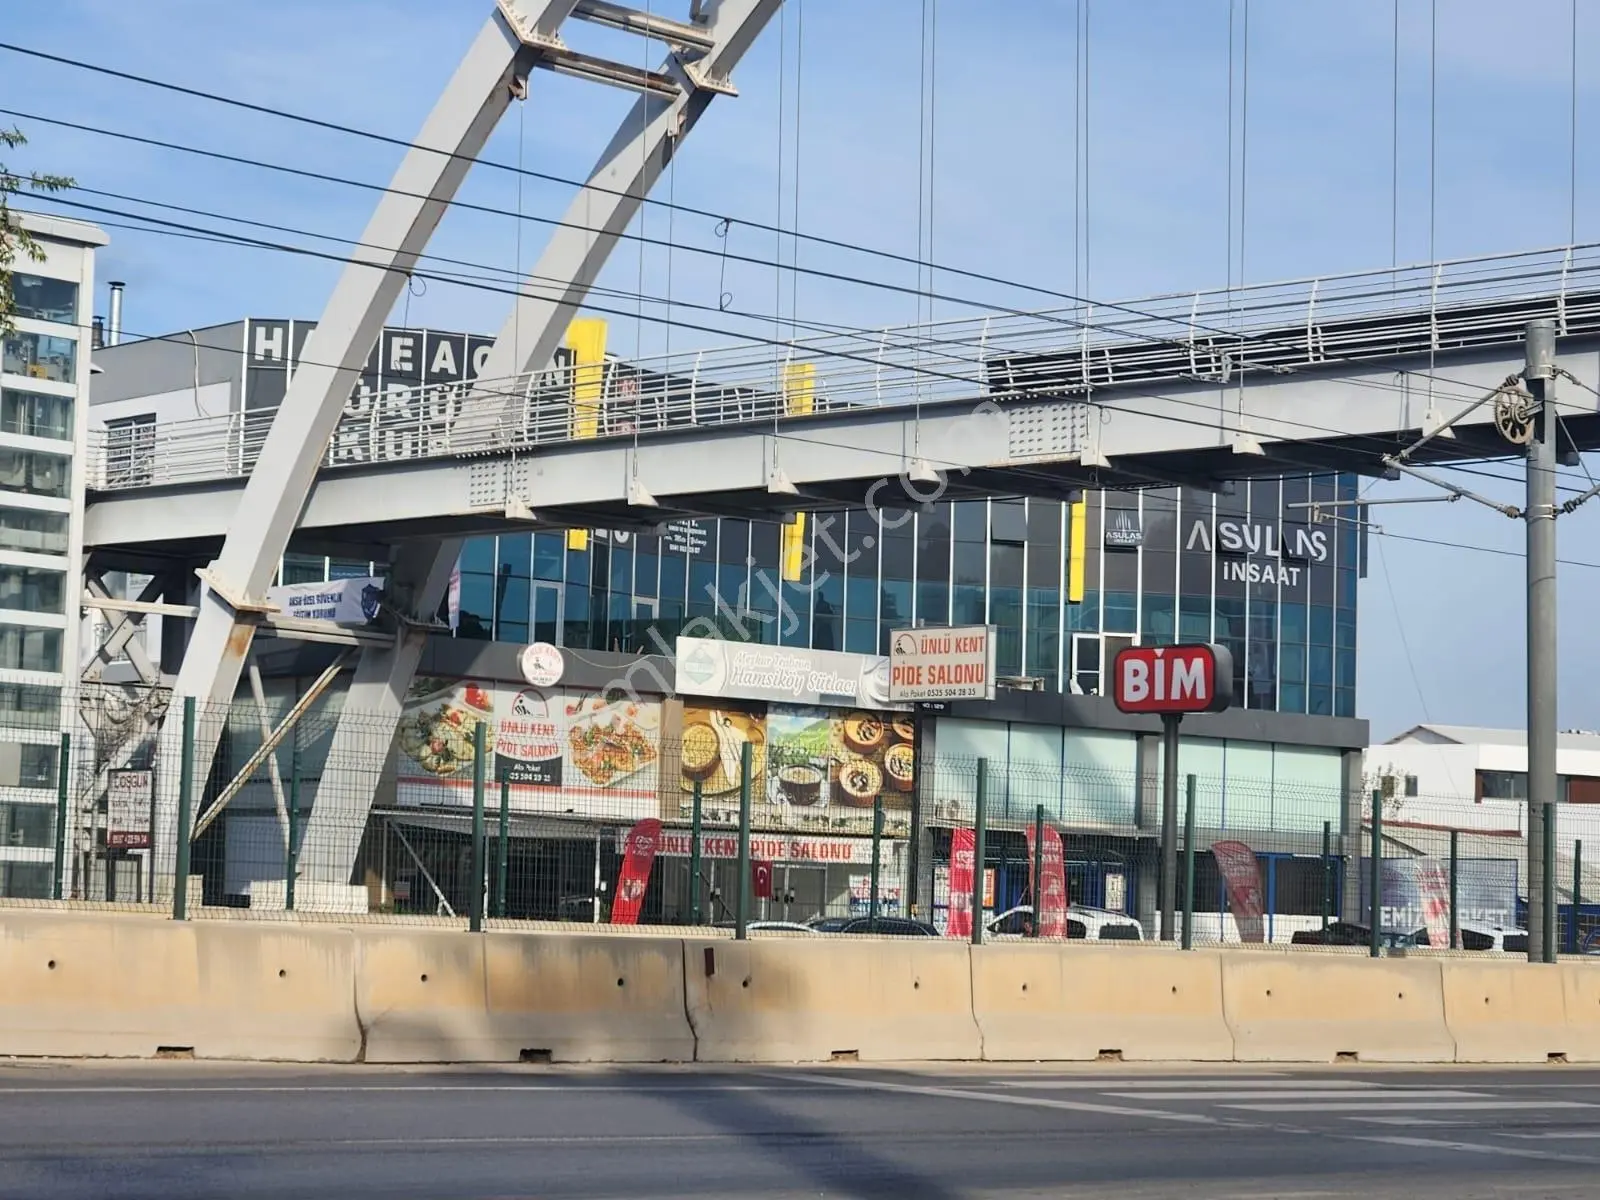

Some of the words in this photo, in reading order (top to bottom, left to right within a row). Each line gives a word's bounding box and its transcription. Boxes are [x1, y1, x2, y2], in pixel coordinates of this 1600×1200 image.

[921, 633, 951, 655] ÜNLÜ
[955, 636, 985, 653] KENT
[730, 664, 804, 696] Hamsiköy
[892, 660, 922, 686] PİDE
[927, 663, 984, 685] SALONU
[1123, 648, 1206, 702] BİM
[910, 689, 926, 698] Paket
[944, 688, 956, 697] 504
[705, 838, 737, 856] KEN
